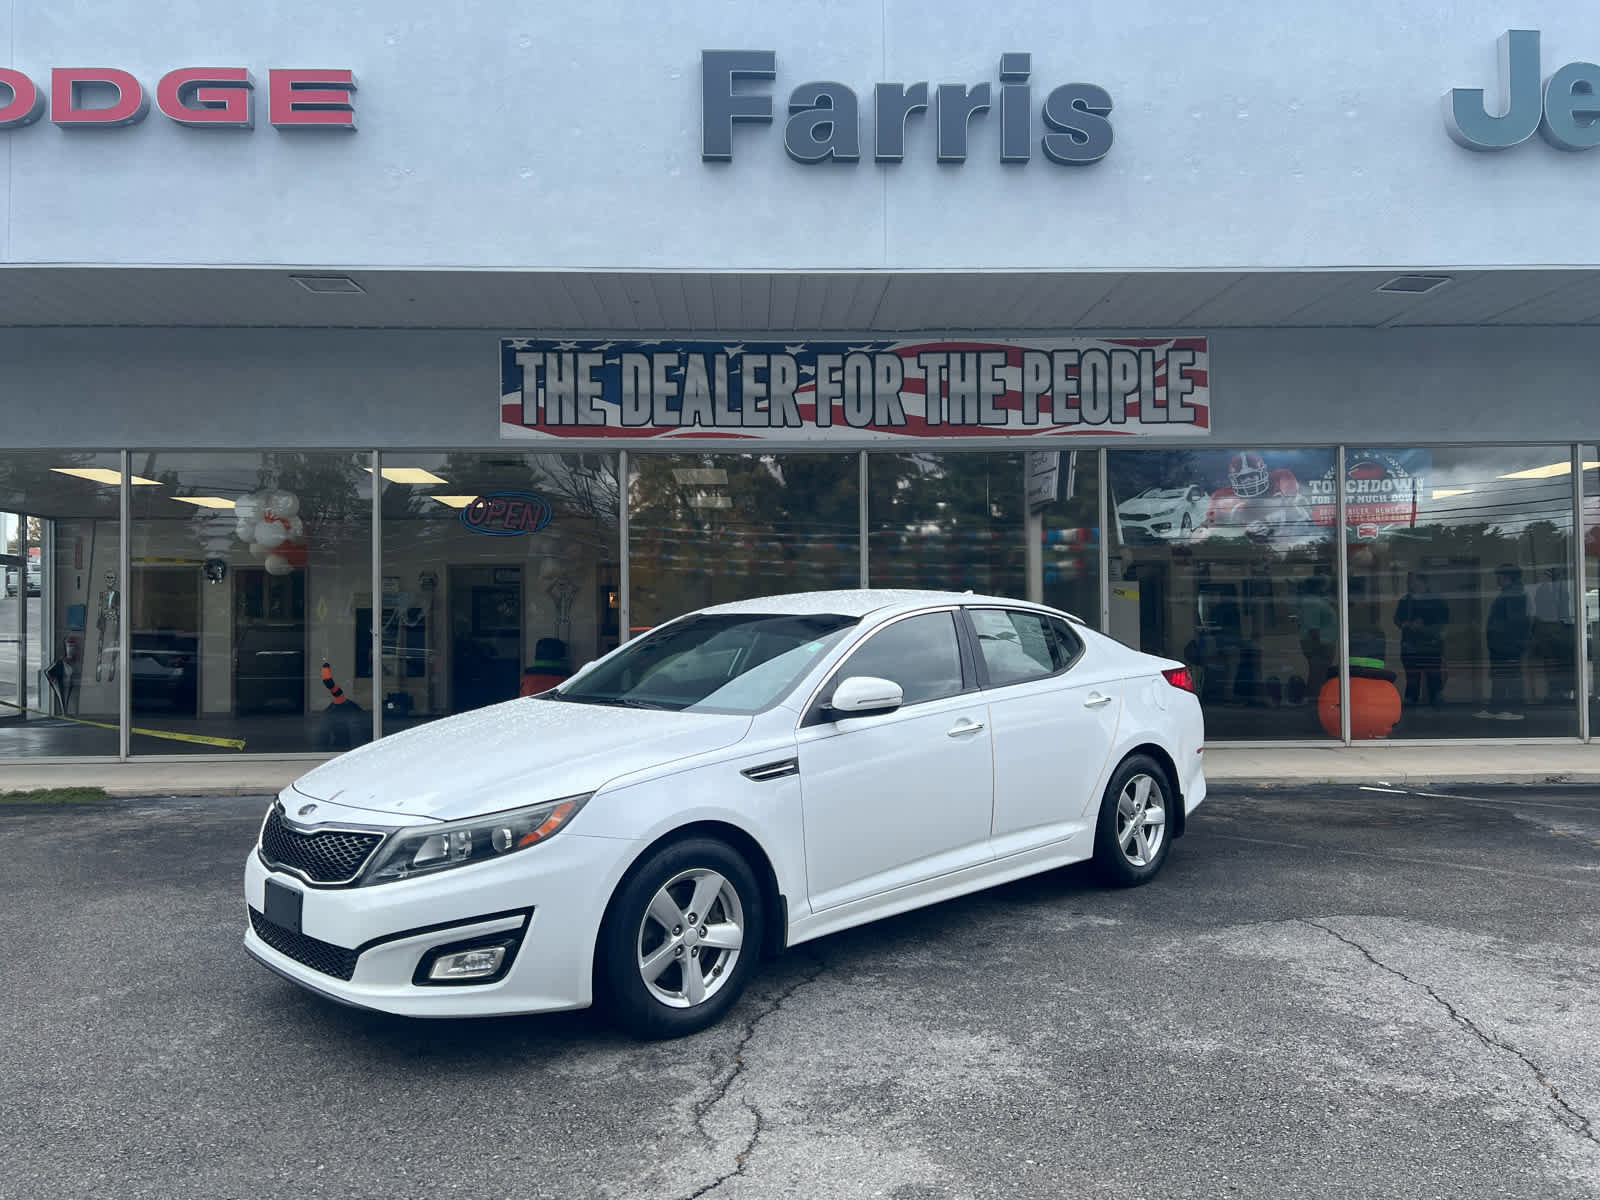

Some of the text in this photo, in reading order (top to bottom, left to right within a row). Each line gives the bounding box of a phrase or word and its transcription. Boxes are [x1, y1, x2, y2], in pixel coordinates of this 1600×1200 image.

[701, 50, 1114, 164] Farris
[1443, 30, 1600, 151] Je
[515, 348, 1196, 428] THE DEALER FOR THE PEOPLE
[468, 497, 542, 532] OPEN
